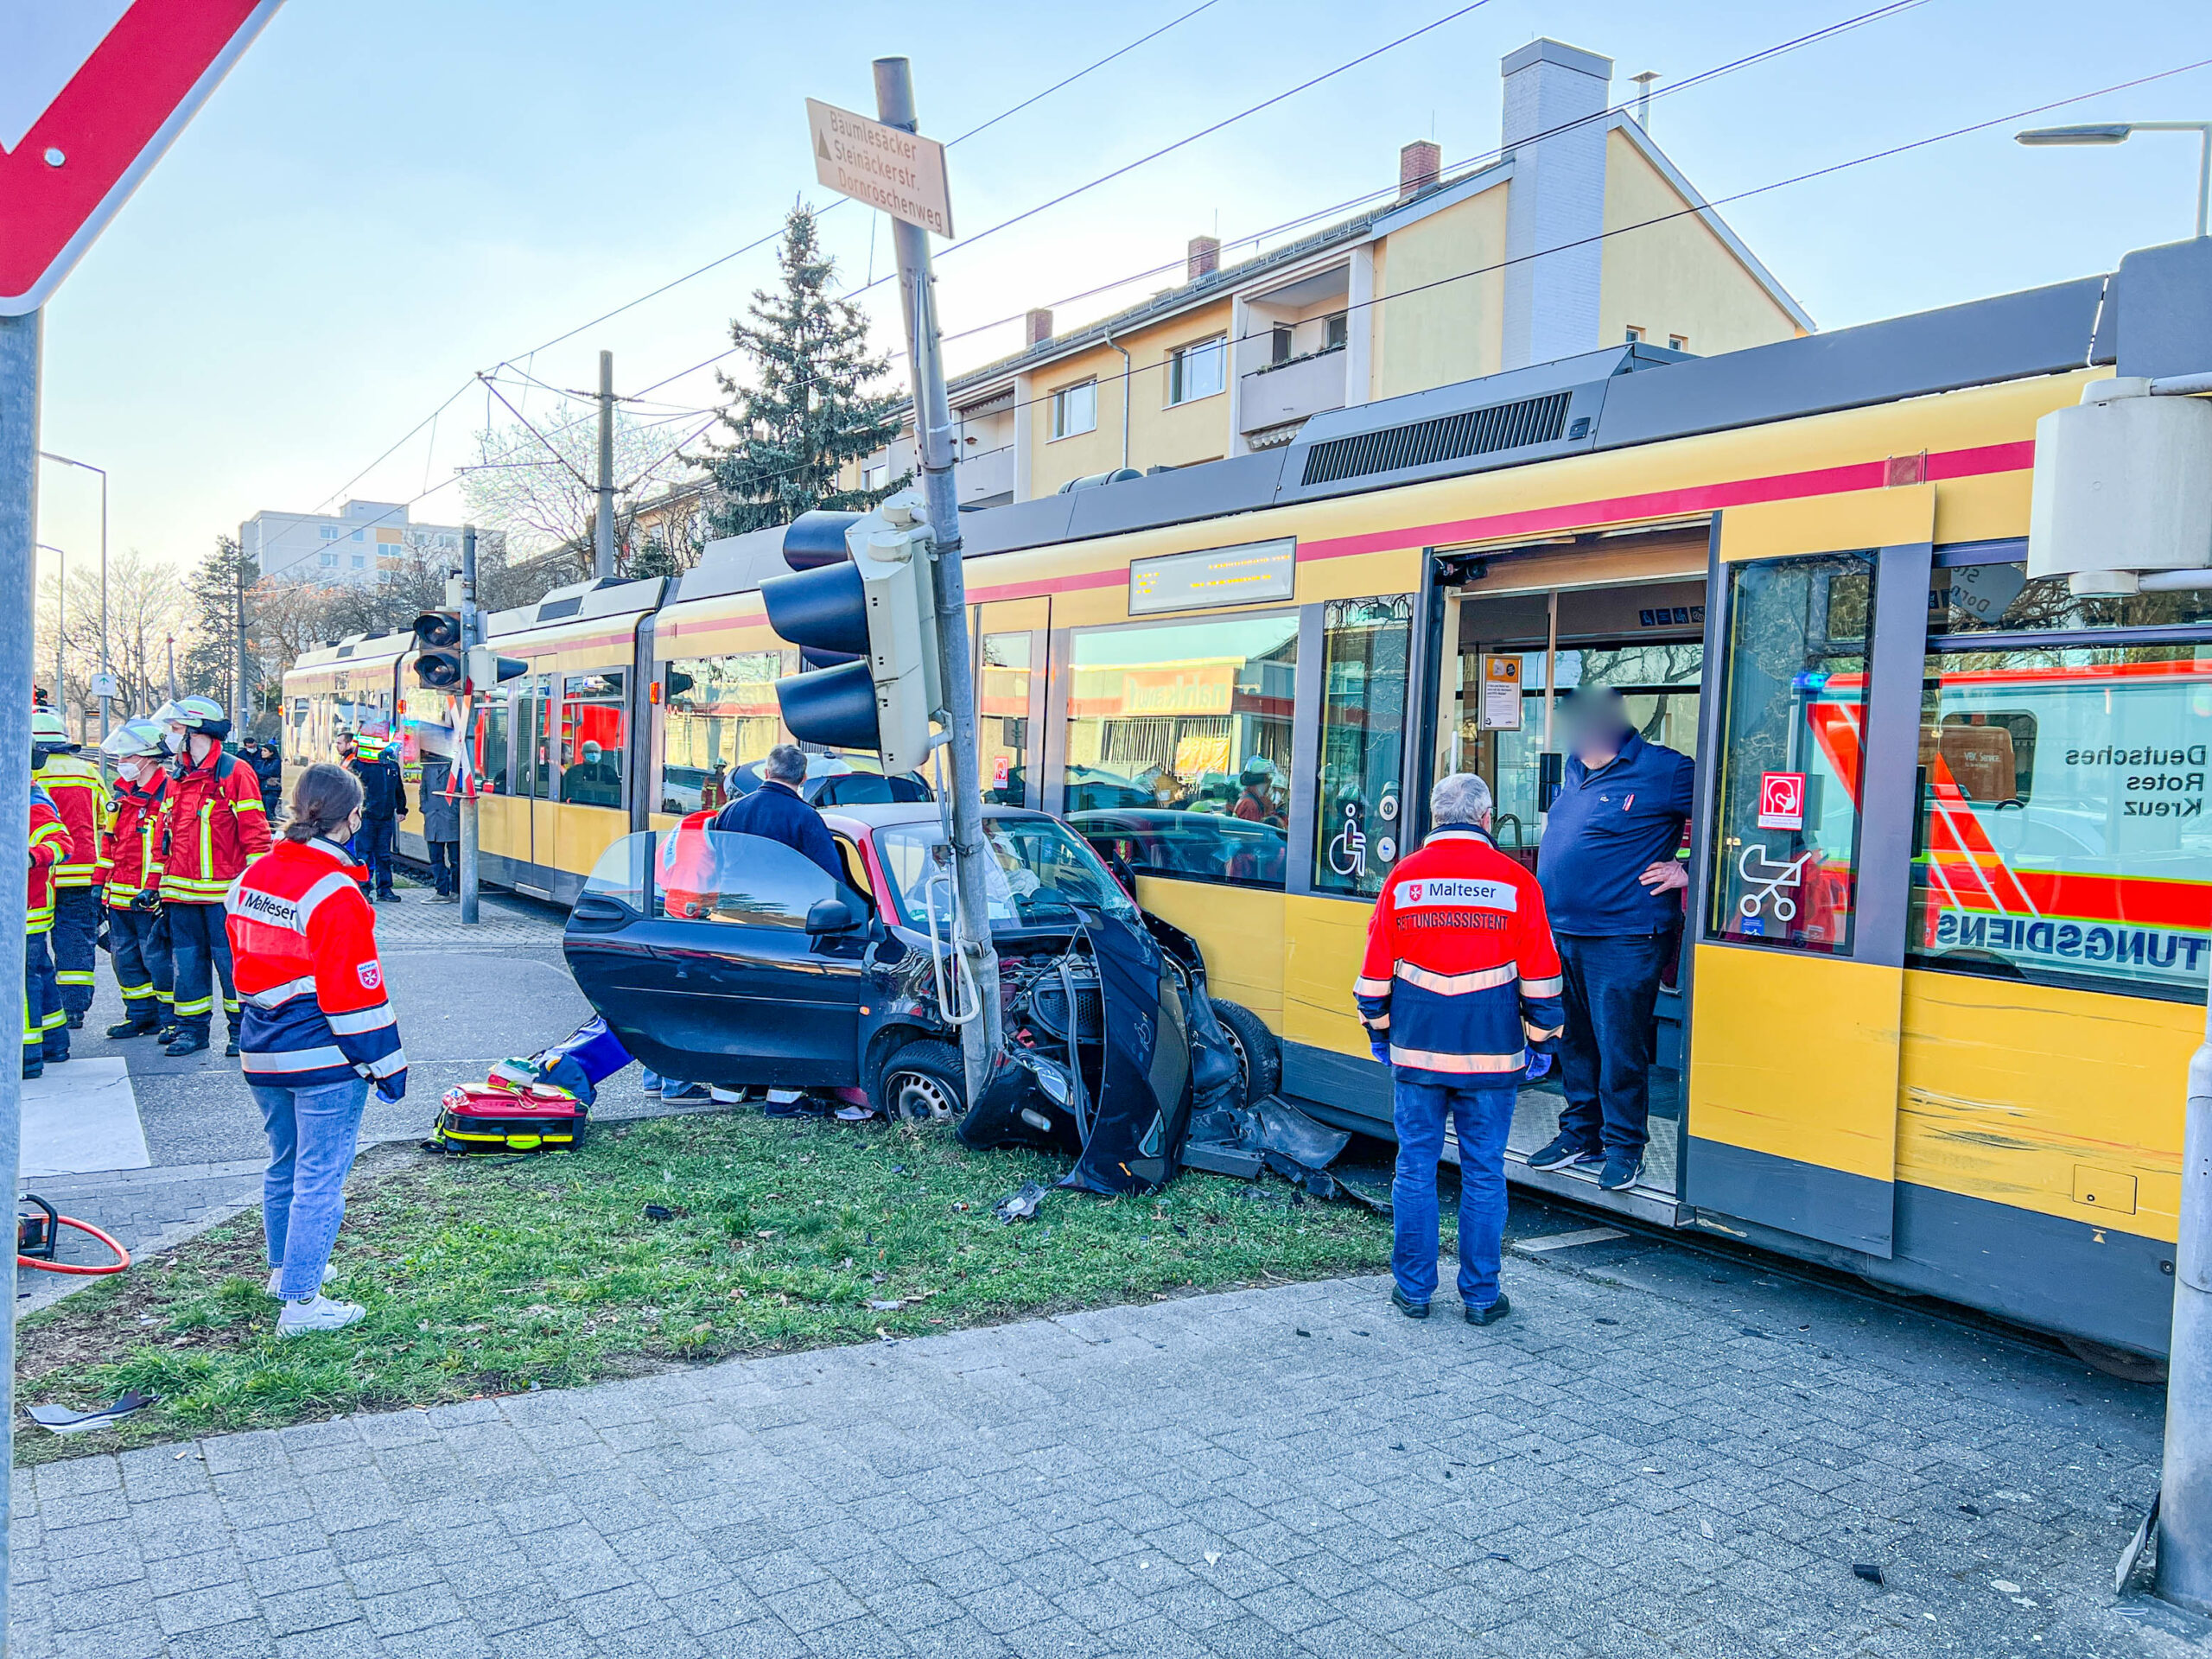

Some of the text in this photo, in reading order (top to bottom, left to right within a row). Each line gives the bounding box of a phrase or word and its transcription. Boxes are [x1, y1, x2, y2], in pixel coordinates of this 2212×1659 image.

[830, 110, 917, 162] Bäumlesäcker
[834, 139, 921, 192] Steinäckerstr.
[837, 166, 943, 233] Dornröschenweg
[245, 893, 297, 921] Malteser
[1429, 882, 1497, 899] Malteser
[1395, 912, 1509, 931] RETTUNGSASSISTENT
